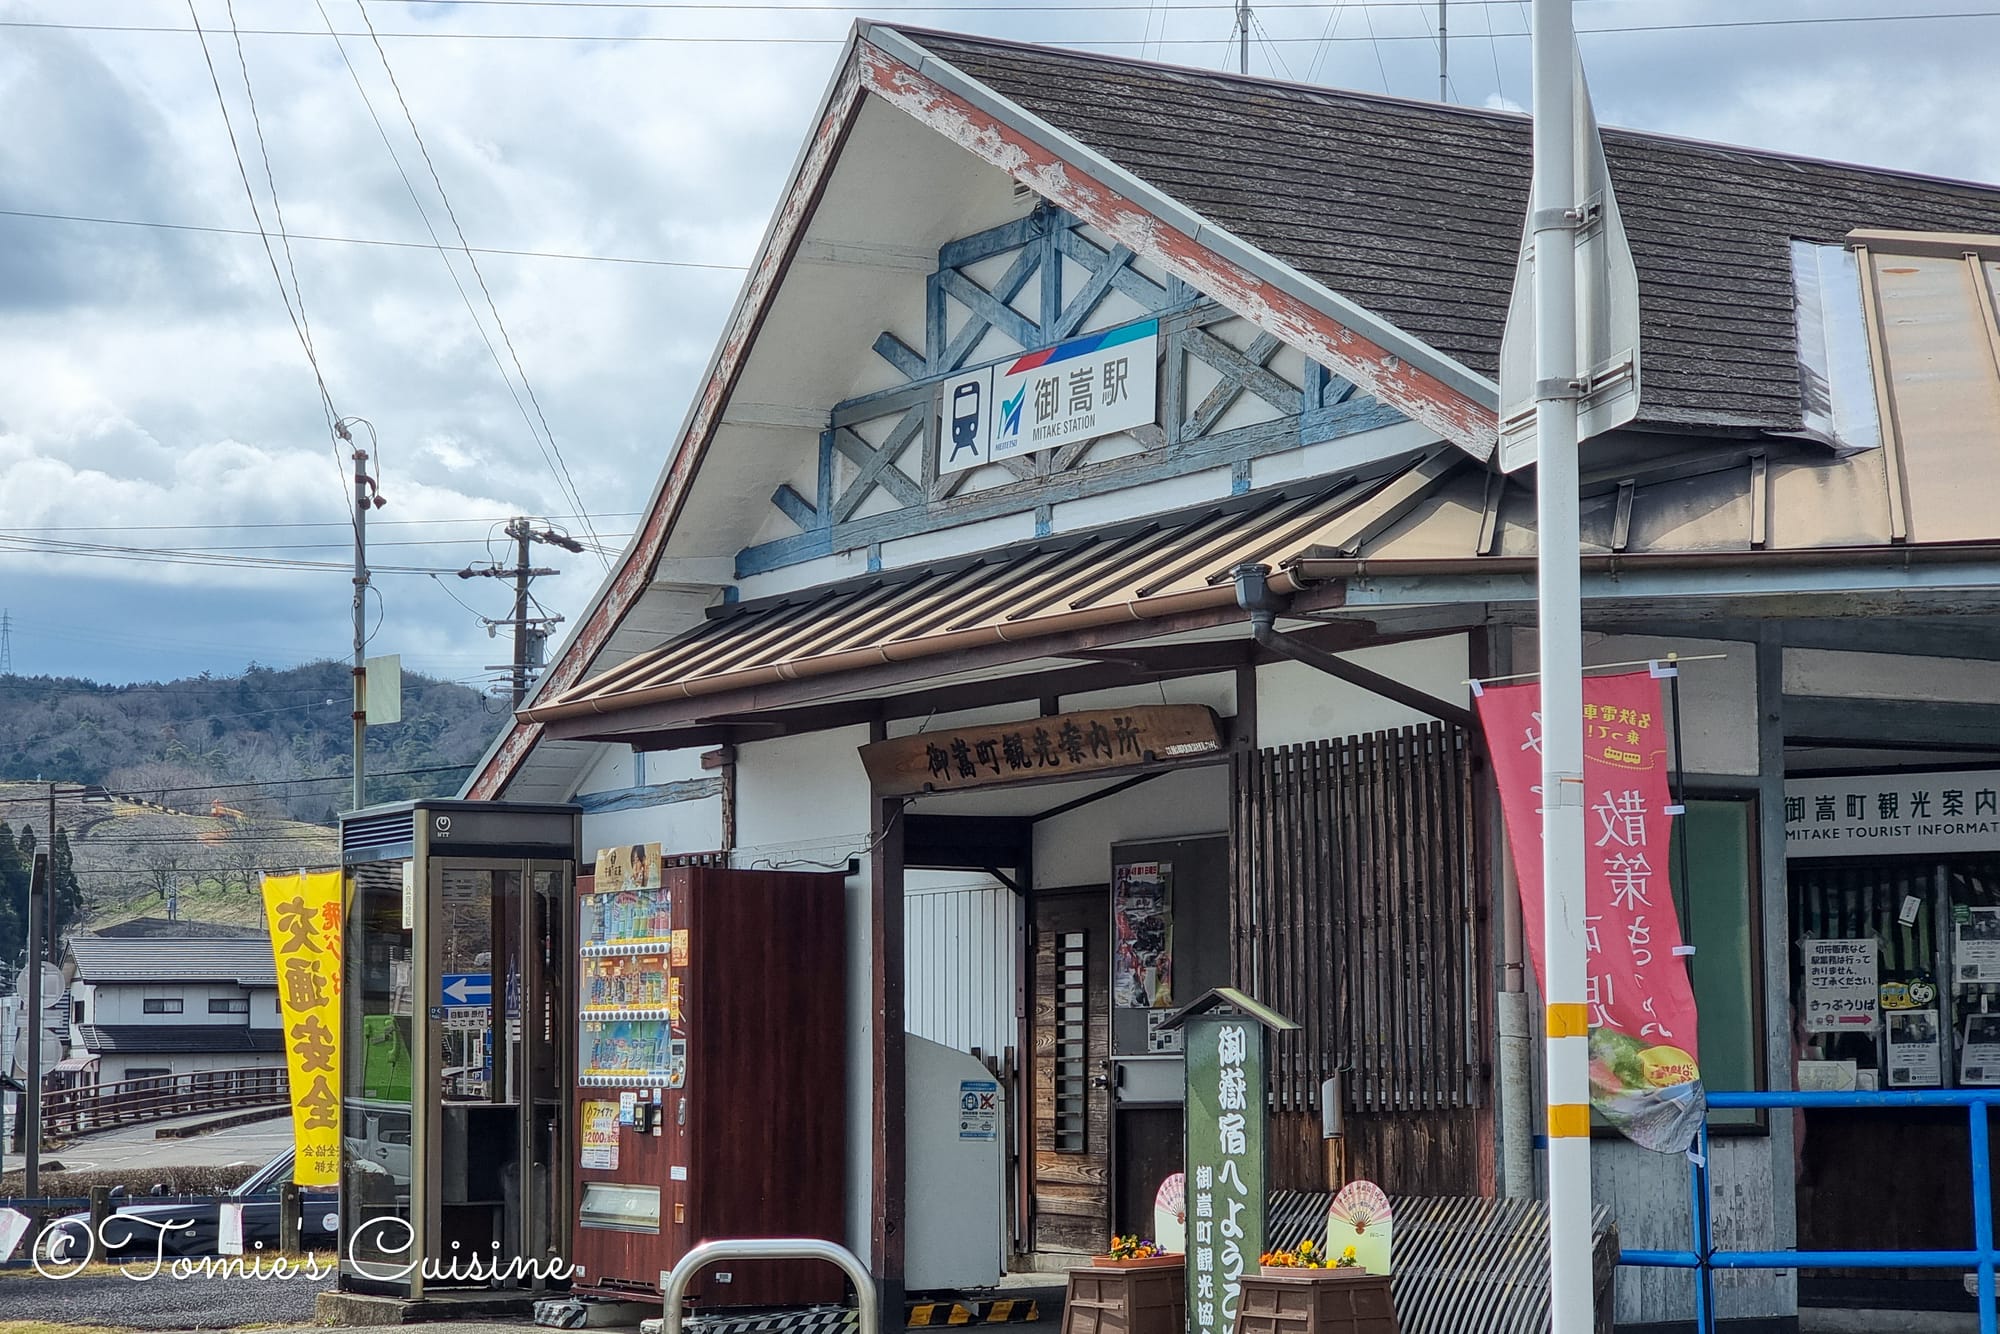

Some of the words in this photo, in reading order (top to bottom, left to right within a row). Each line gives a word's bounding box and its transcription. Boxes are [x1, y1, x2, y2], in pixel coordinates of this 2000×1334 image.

[1034, 357, 1128, 425] 御嵩駅
[1032, 421, 1062, 442] MITAKE
[1063, 413, 1096, 437] STATION
[1784, 788, 1997, 823] 御嵩町観光案内
[1785, 827, 1841, 841] MITAKE
[1845, 825, 1912, 838] TOURIST
[1810, 998, 1876, 1011] きっぷうりば
[450, 1019, 485, 1027] ここまで
[1196, 1165, 1214, 1334] 御嵩町観光協
